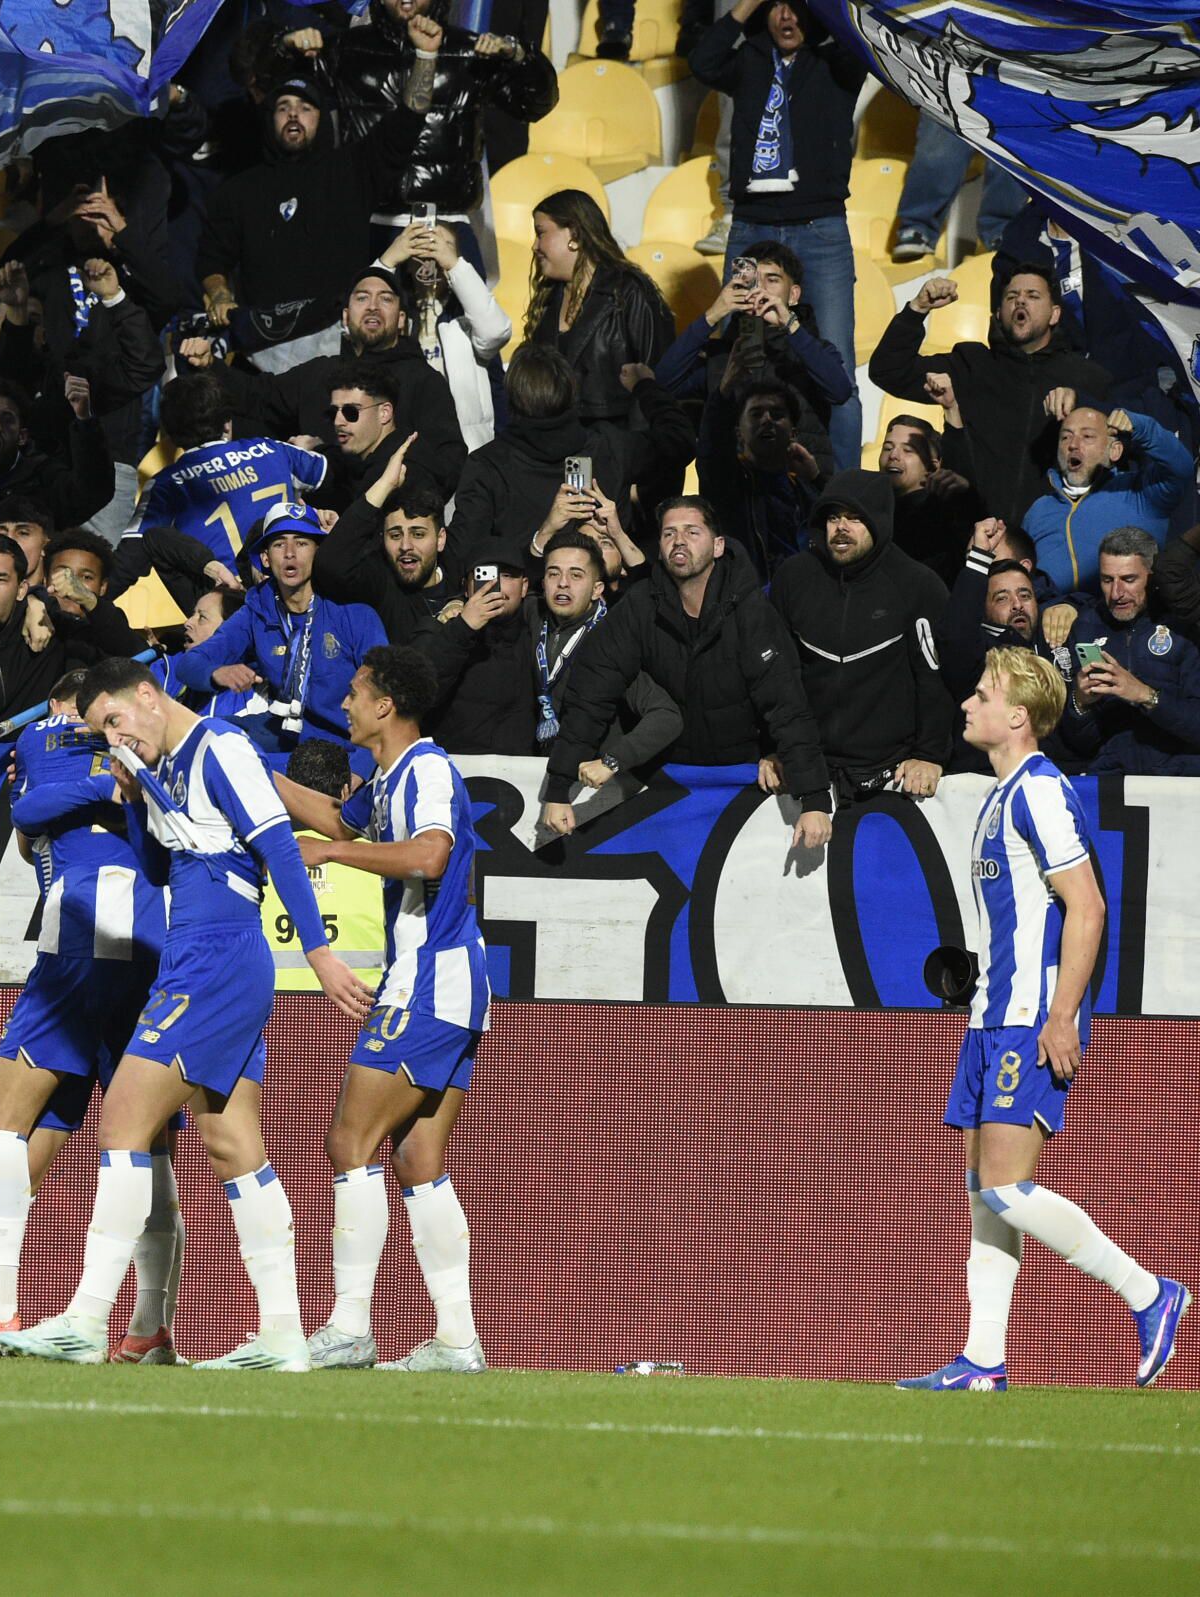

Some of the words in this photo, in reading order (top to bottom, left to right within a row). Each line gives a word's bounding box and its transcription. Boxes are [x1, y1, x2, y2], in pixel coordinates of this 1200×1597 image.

[171, 456, 227, 486] SUPER
[225, 441, 275, 467] BOCK
[208, 465, 259, 495] TOMÁS
[274, 913, 340, 944] 95
[137, 989, 190, 1031] 27
[996, 1050, 1022, 1092] 8
